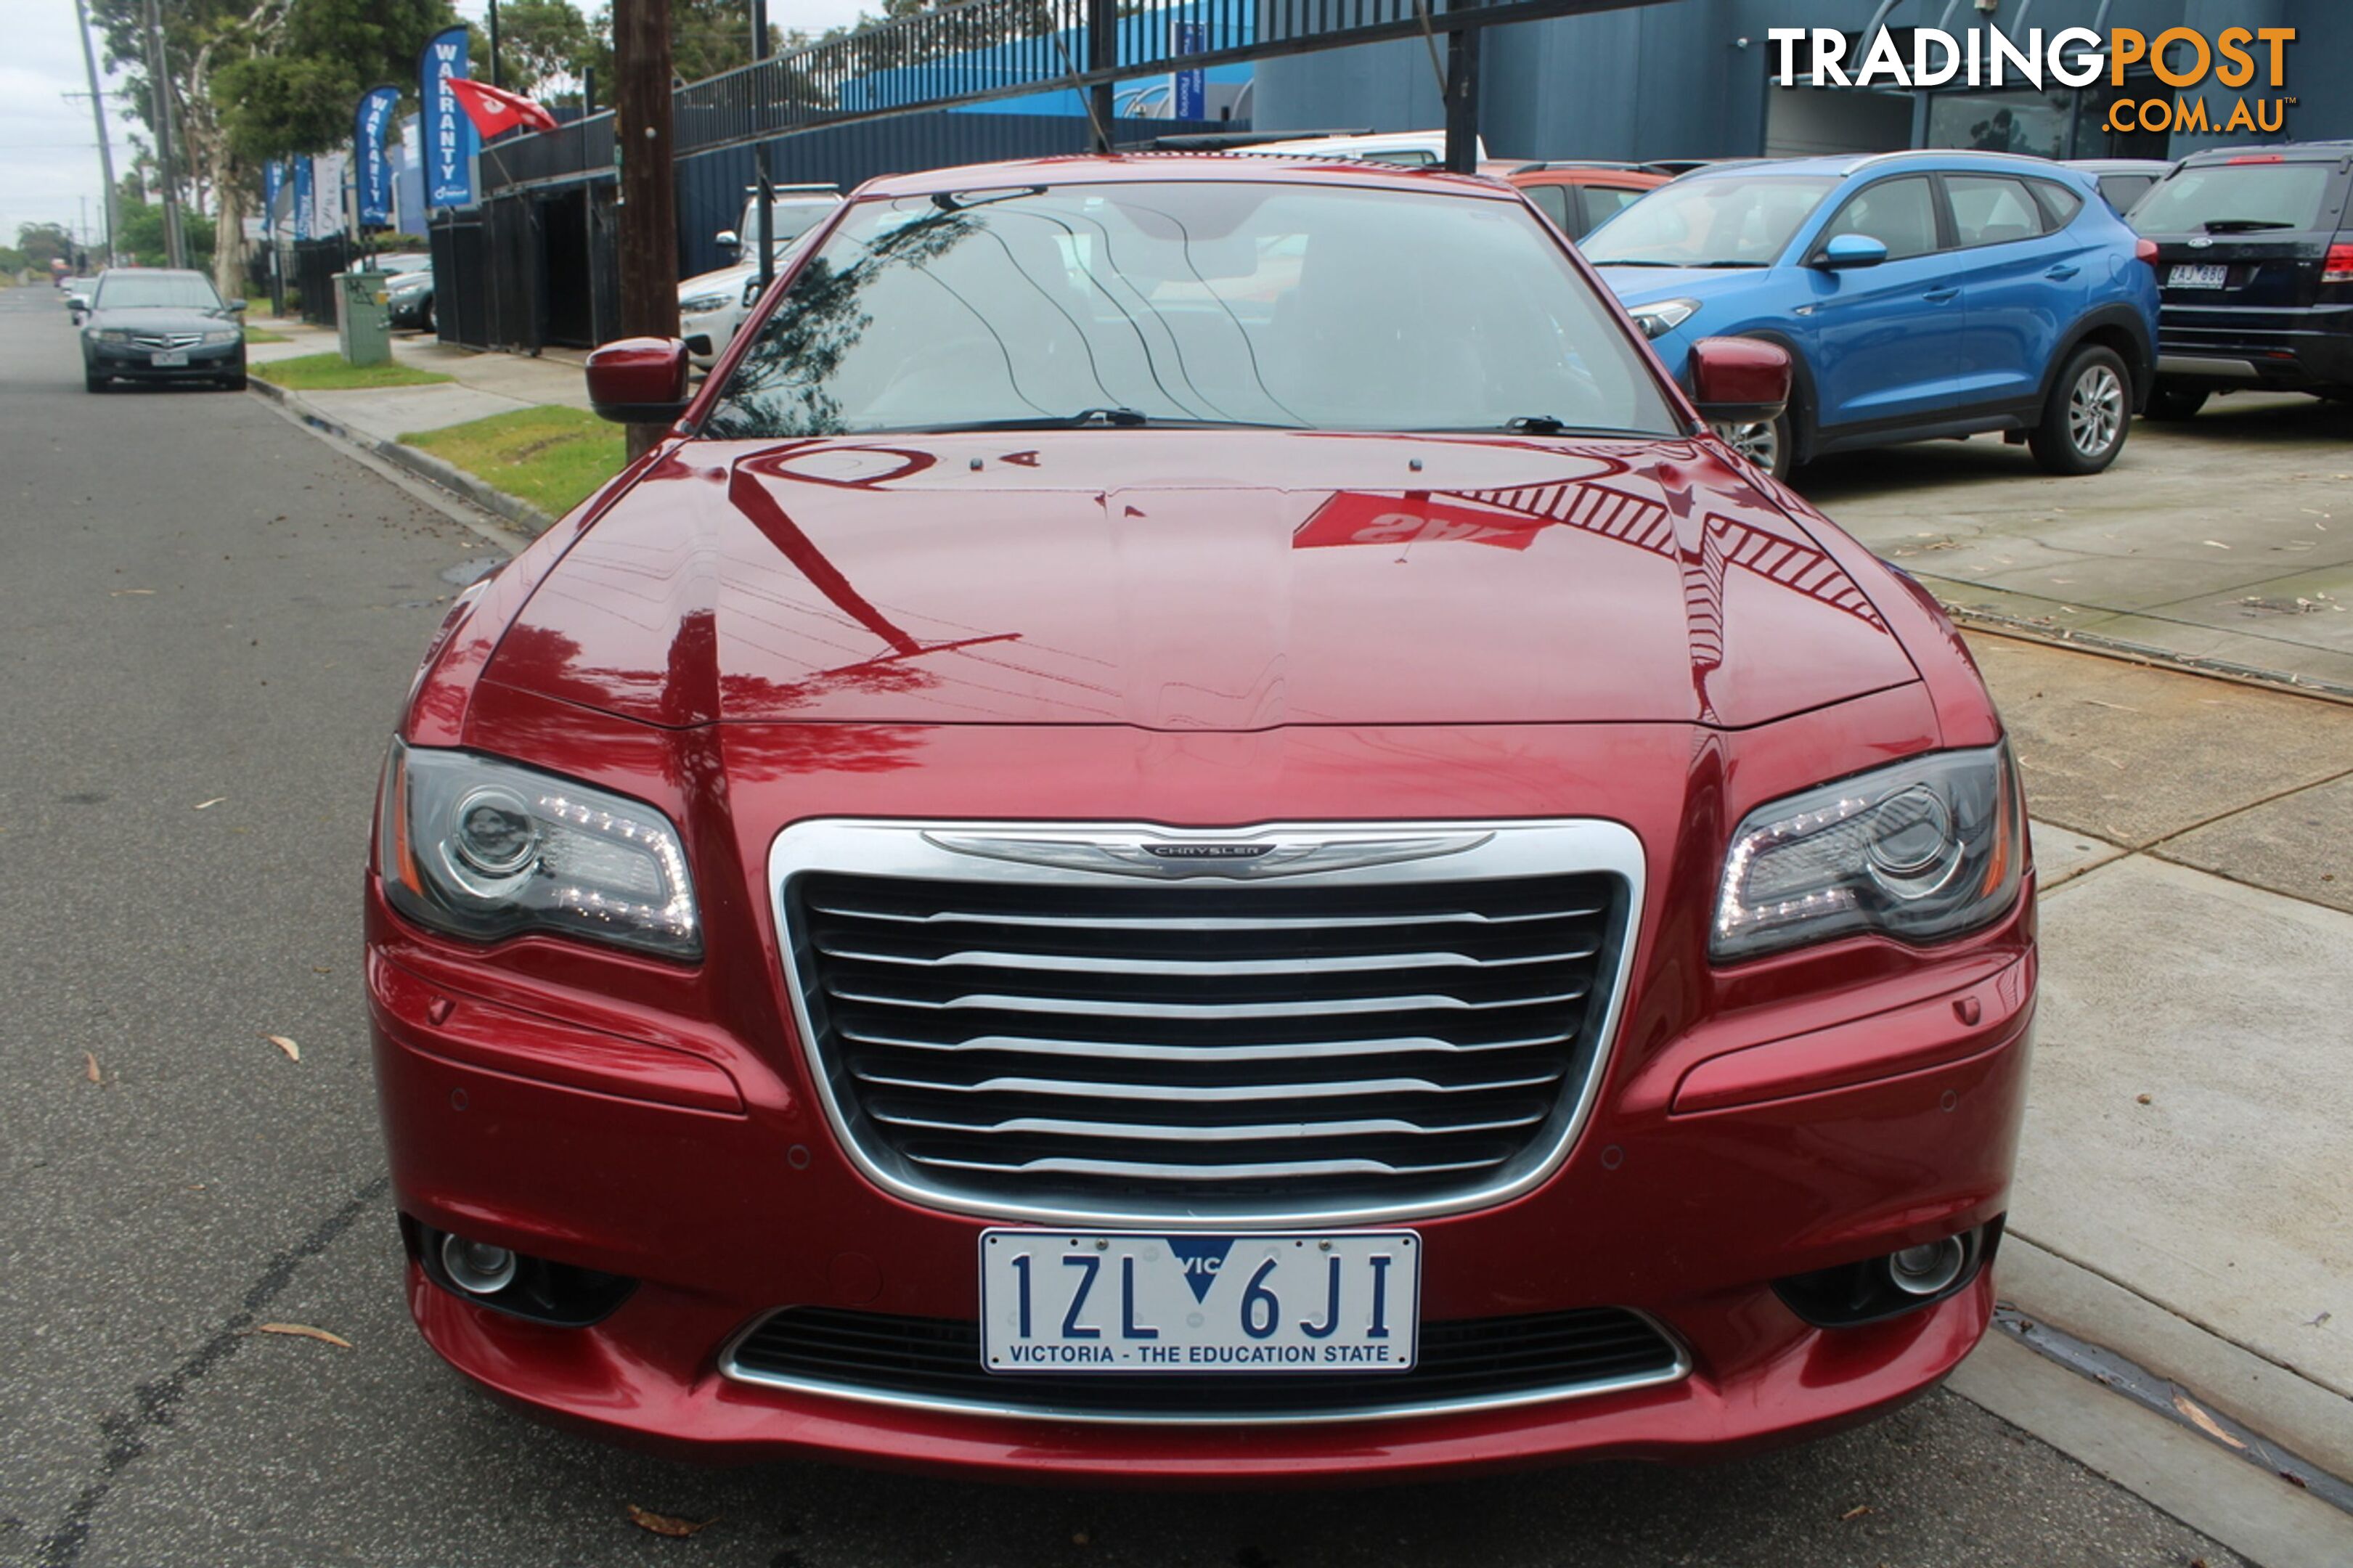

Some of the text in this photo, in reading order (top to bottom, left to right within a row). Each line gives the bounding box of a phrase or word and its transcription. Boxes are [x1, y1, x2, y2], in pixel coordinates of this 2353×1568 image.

[1154, 846, 1260, 855] CHRYSLER
[1179, 1256, 1221, 1275] VIC
[1011, 1254, 1392, 1339] 1ZL 6JI
[1010, 1346, 1114, 1362] VICTORIA
[1138, 1346, 1180, 1362] THE
[1188, 1345, 1316, 1363] EDUCATION
[1324, 1345, 1389, 1362] STATE
